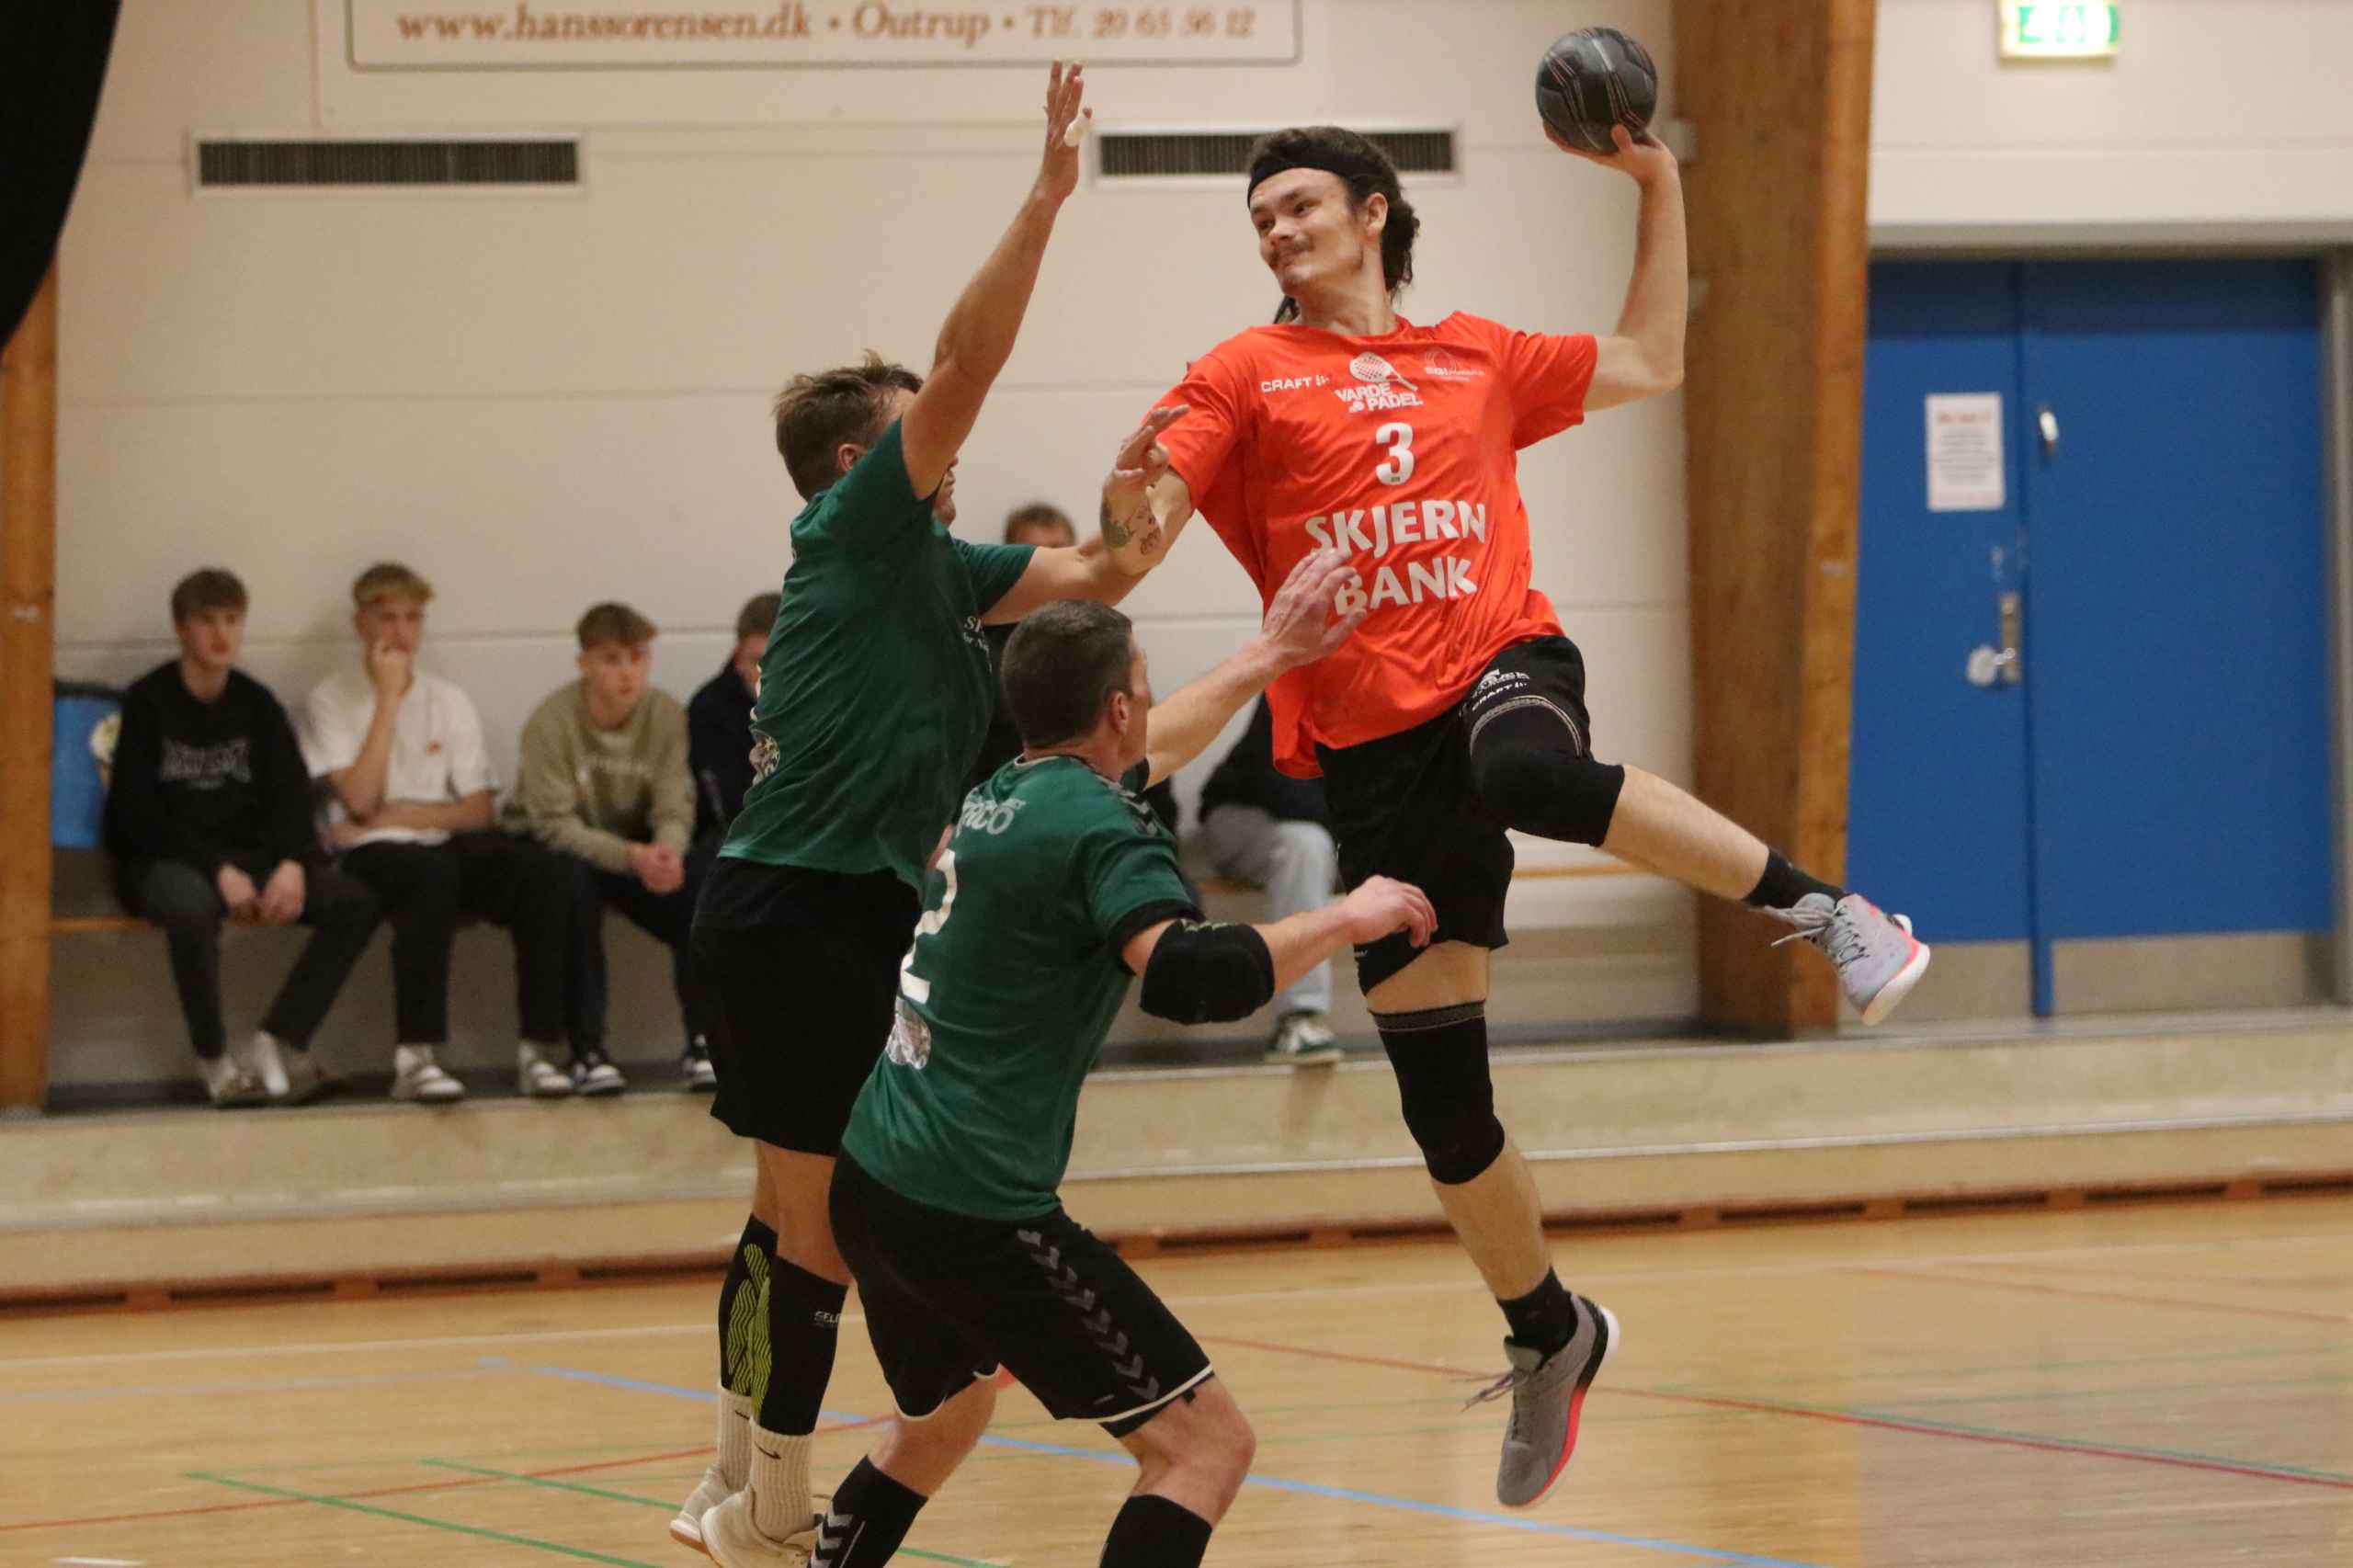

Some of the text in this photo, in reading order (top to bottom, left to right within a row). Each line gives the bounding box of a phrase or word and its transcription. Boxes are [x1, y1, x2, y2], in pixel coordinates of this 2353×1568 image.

[853, 1, 992, 48] Outrup
[1260, 376, 1313, 393] CRAFT
[1334, 382, 1391, 403] VARDE
[1366, 392, 1424, 412] PADEL
[1375, 422, 1415, 486] 3
[1304, 499, 1486, 559] SKJERN
[1334, 555, 1478, 616] BANK
